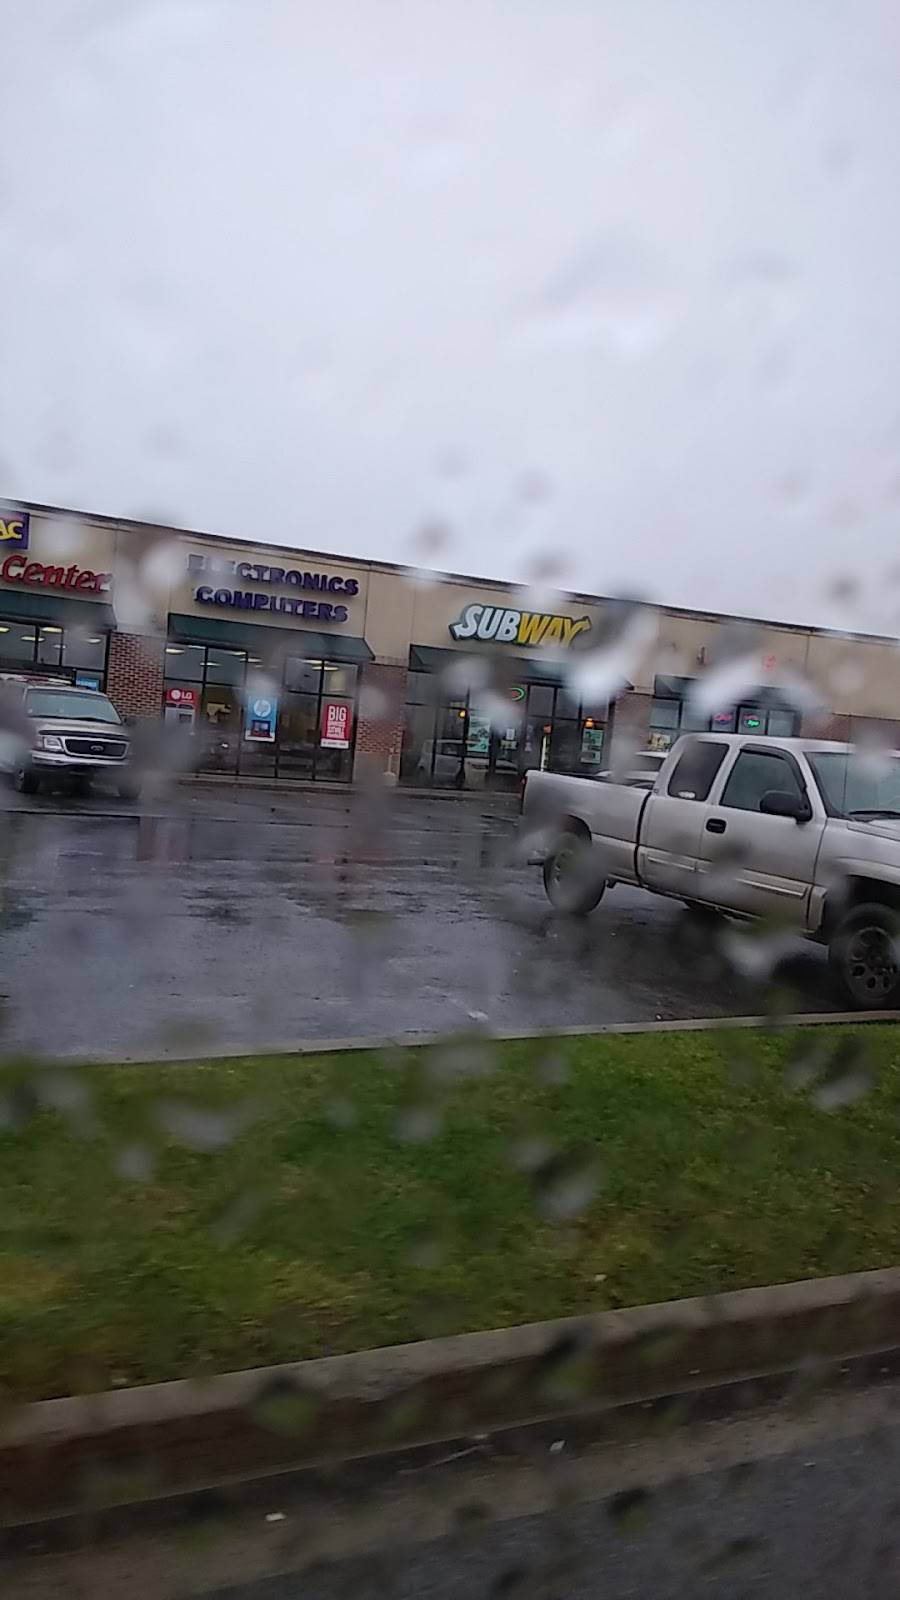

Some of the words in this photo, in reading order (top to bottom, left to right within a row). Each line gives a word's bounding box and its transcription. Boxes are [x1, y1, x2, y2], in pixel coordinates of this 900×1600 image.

[2, 555, 113, 593] Center
[194, 585, 350, 622] COMPUTERS
[451, 604, 591, 647] SUBWAY
[182, 690, 193, 699] LG
[328, 705, 347, 722] BIG
